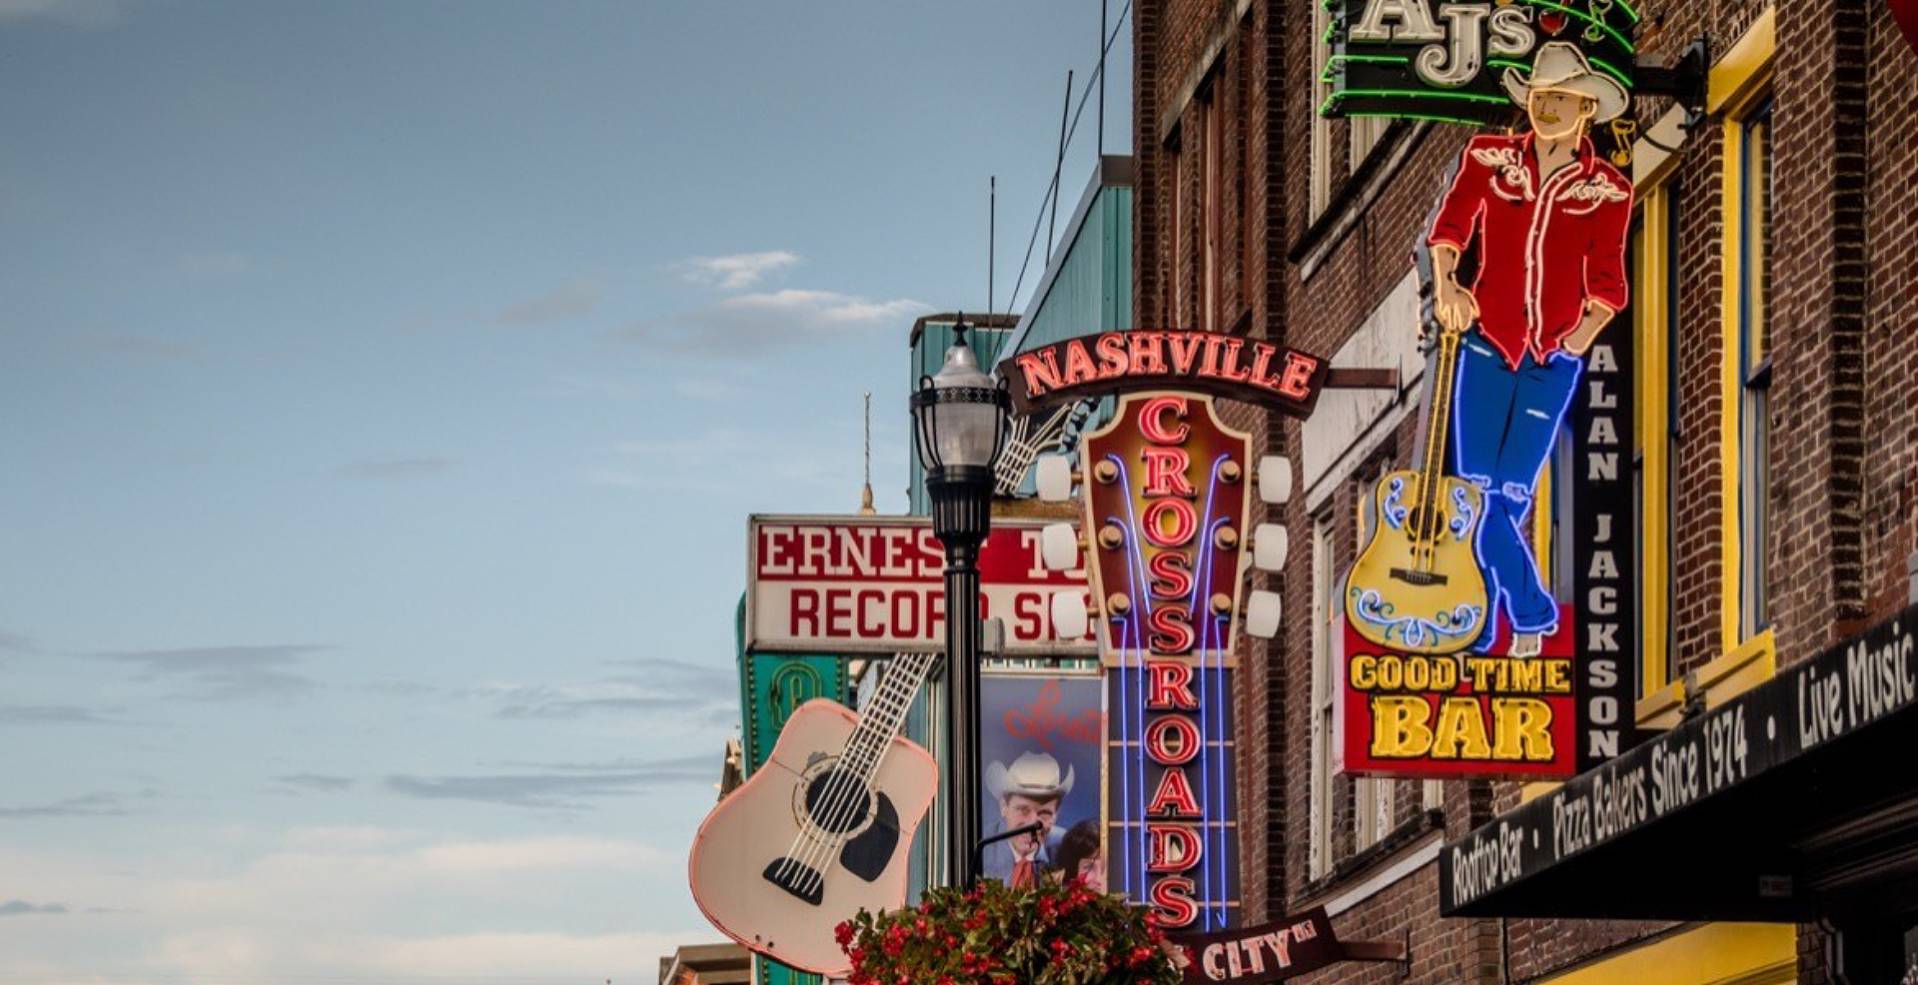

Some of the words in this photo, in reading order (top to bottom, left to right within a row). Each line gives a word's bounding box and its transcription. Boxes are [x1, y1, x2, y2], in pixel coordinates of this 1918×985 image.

[1015, 332, 1317, 398] NASHVILLE
[1588, 344, 1618, 481] ALAN
[761, 526, 988, 577] ERNES
[1137, 396, 1203, 928] CROSSROADS
[1350, 655, 1457, 690] GOOD
[1466, 658, 1571, 693] TIME
[1588, 514, 1619, 758] JACKSON
[1371, 696, 1554, 760] BAR
[1799, 665, 1843, 750] Live
[1847, 621, 1915, 729] Music
[1553, 791, 1591, 861] Pizza
[1593, 764, 1646, 842] Bakers
[1651, 741, 1698, 817] Since
[1703, 704, 1748, 794] 1974
[1452, 833, 1498, 907] Rooftop
[1500, 820, 1524, 883] Bar
[1202, 929, 1292, 981] CITY
